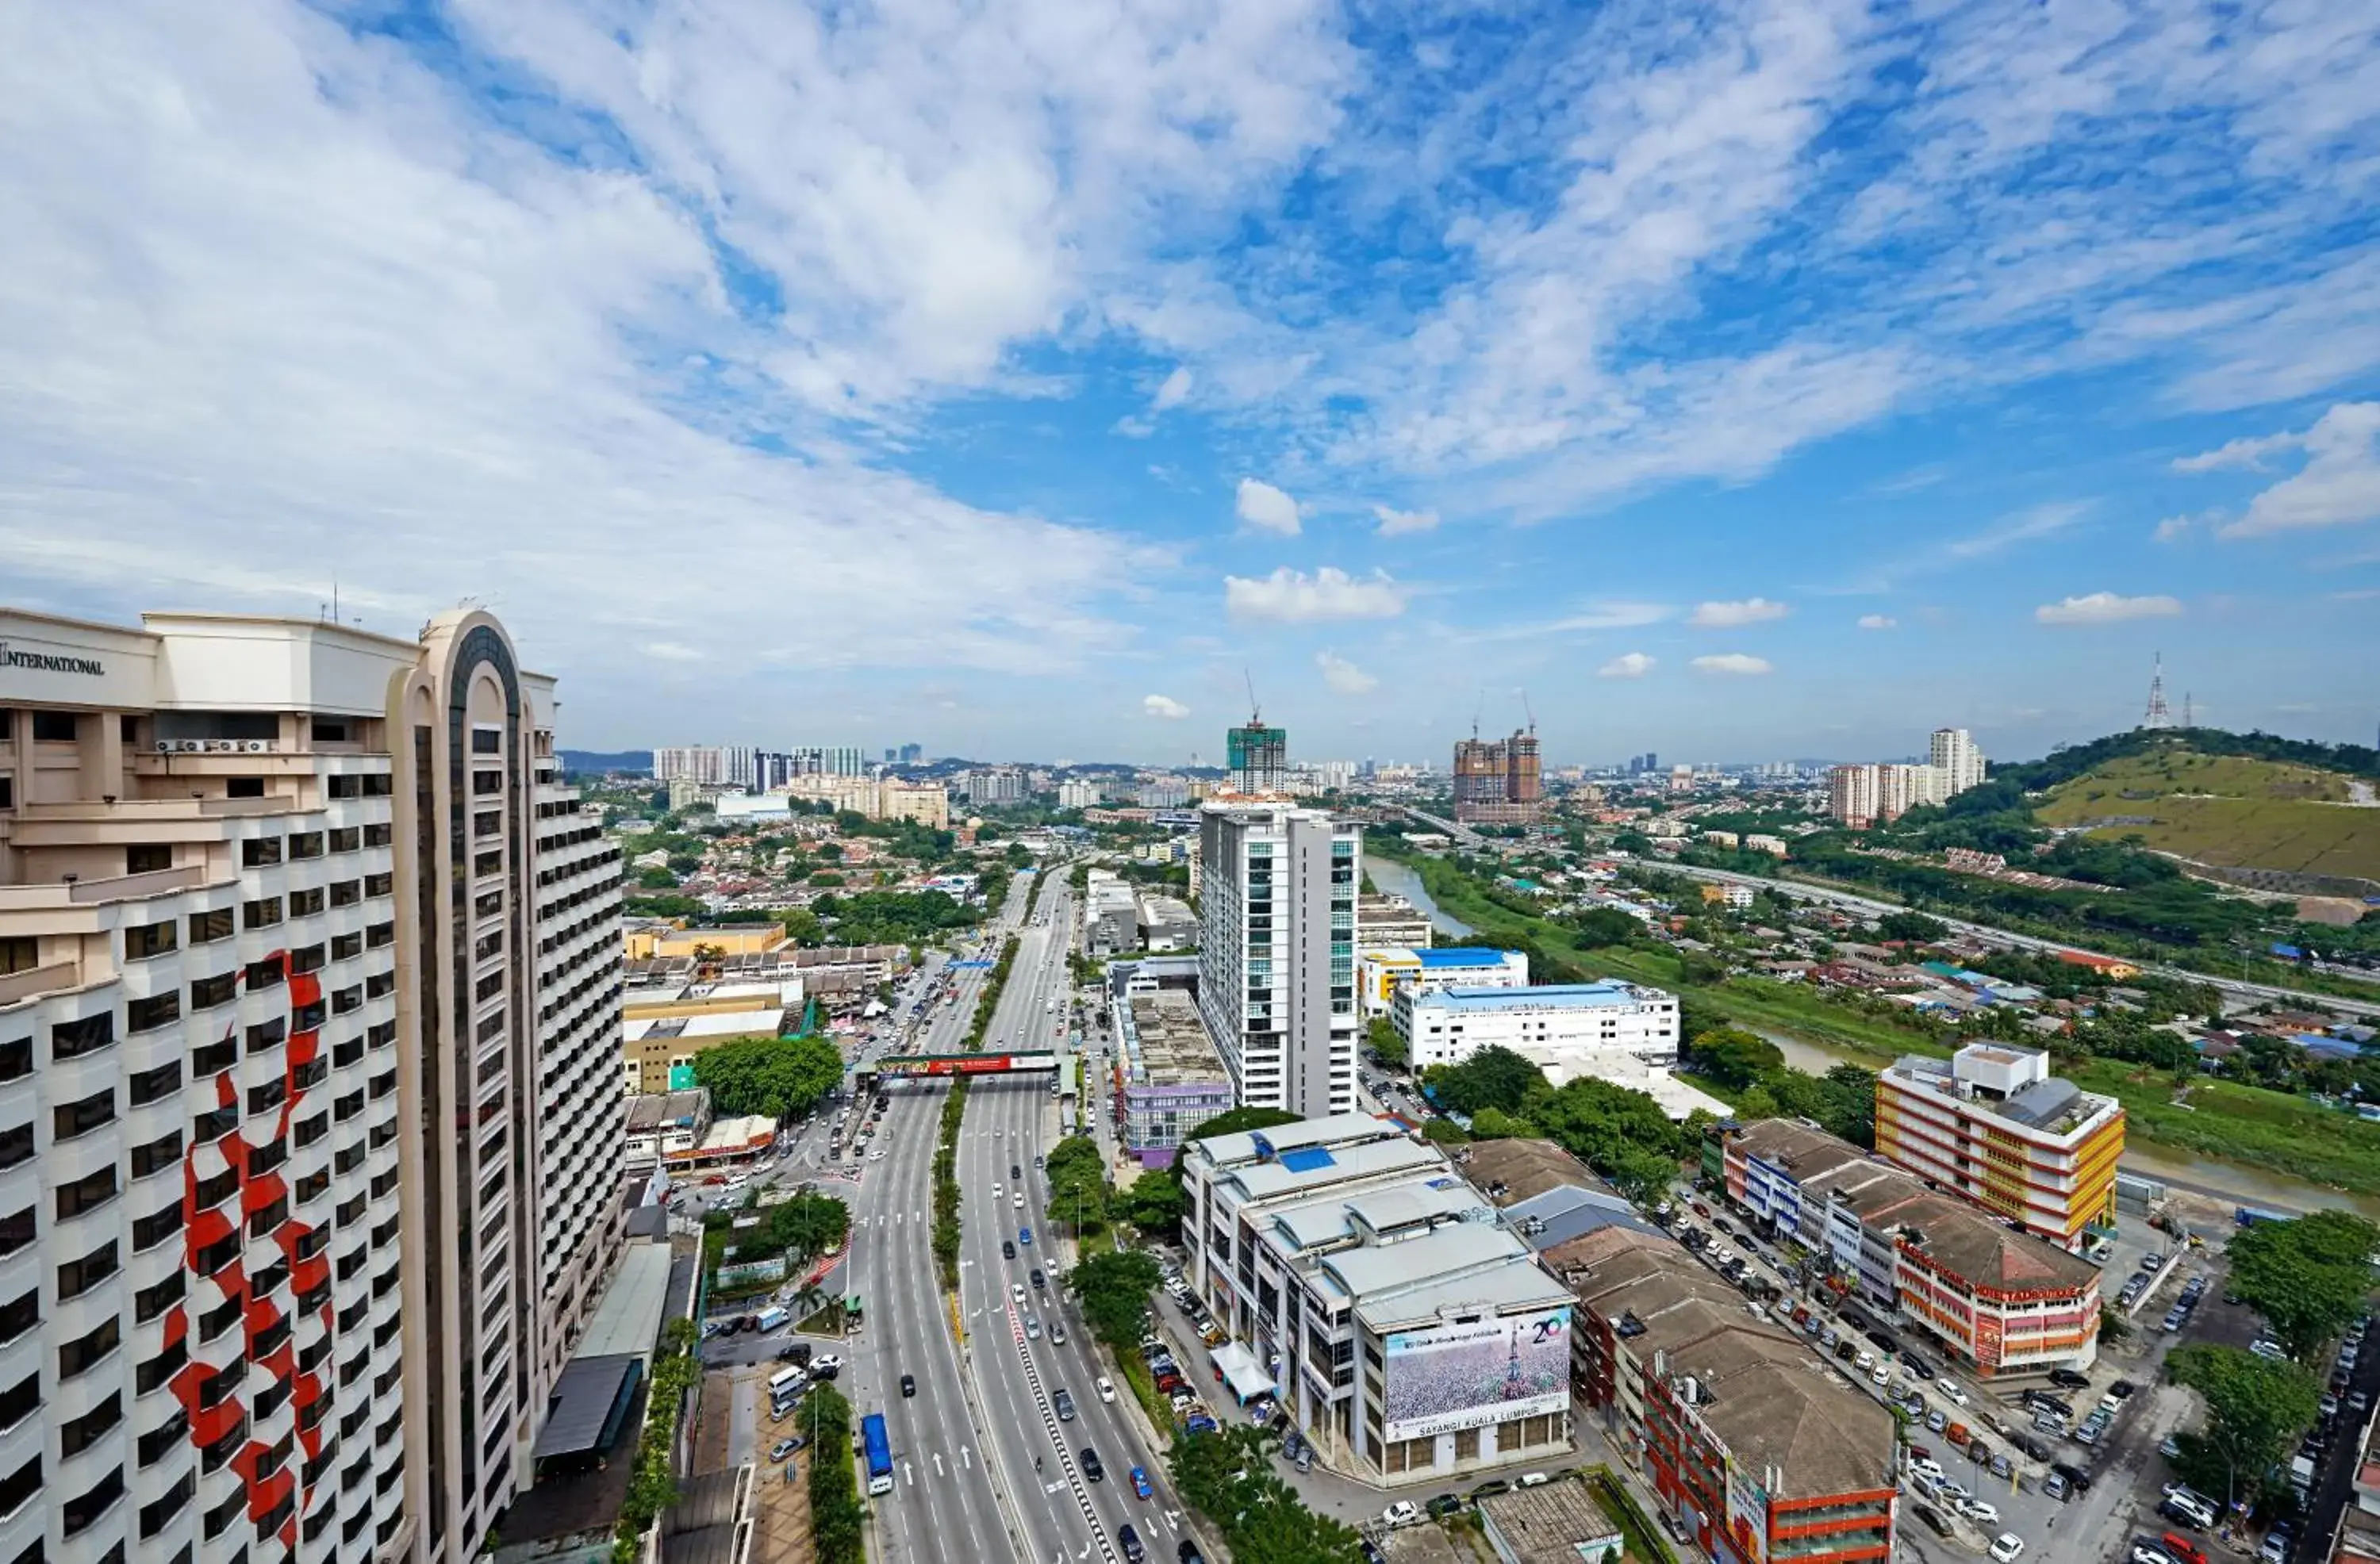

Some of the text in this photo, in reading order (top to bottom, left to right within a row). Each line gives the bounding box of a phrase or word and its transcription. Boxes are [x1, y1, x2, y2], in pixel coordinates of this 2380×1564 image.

[1532, 1317, 1562, 1344] 20
[1419, 1422, 1461, 1436] SAYANGI
[1465, 1415, 1495, 1428] KUALA
[1500, 1406, 1540, 1421] LUMPUR
